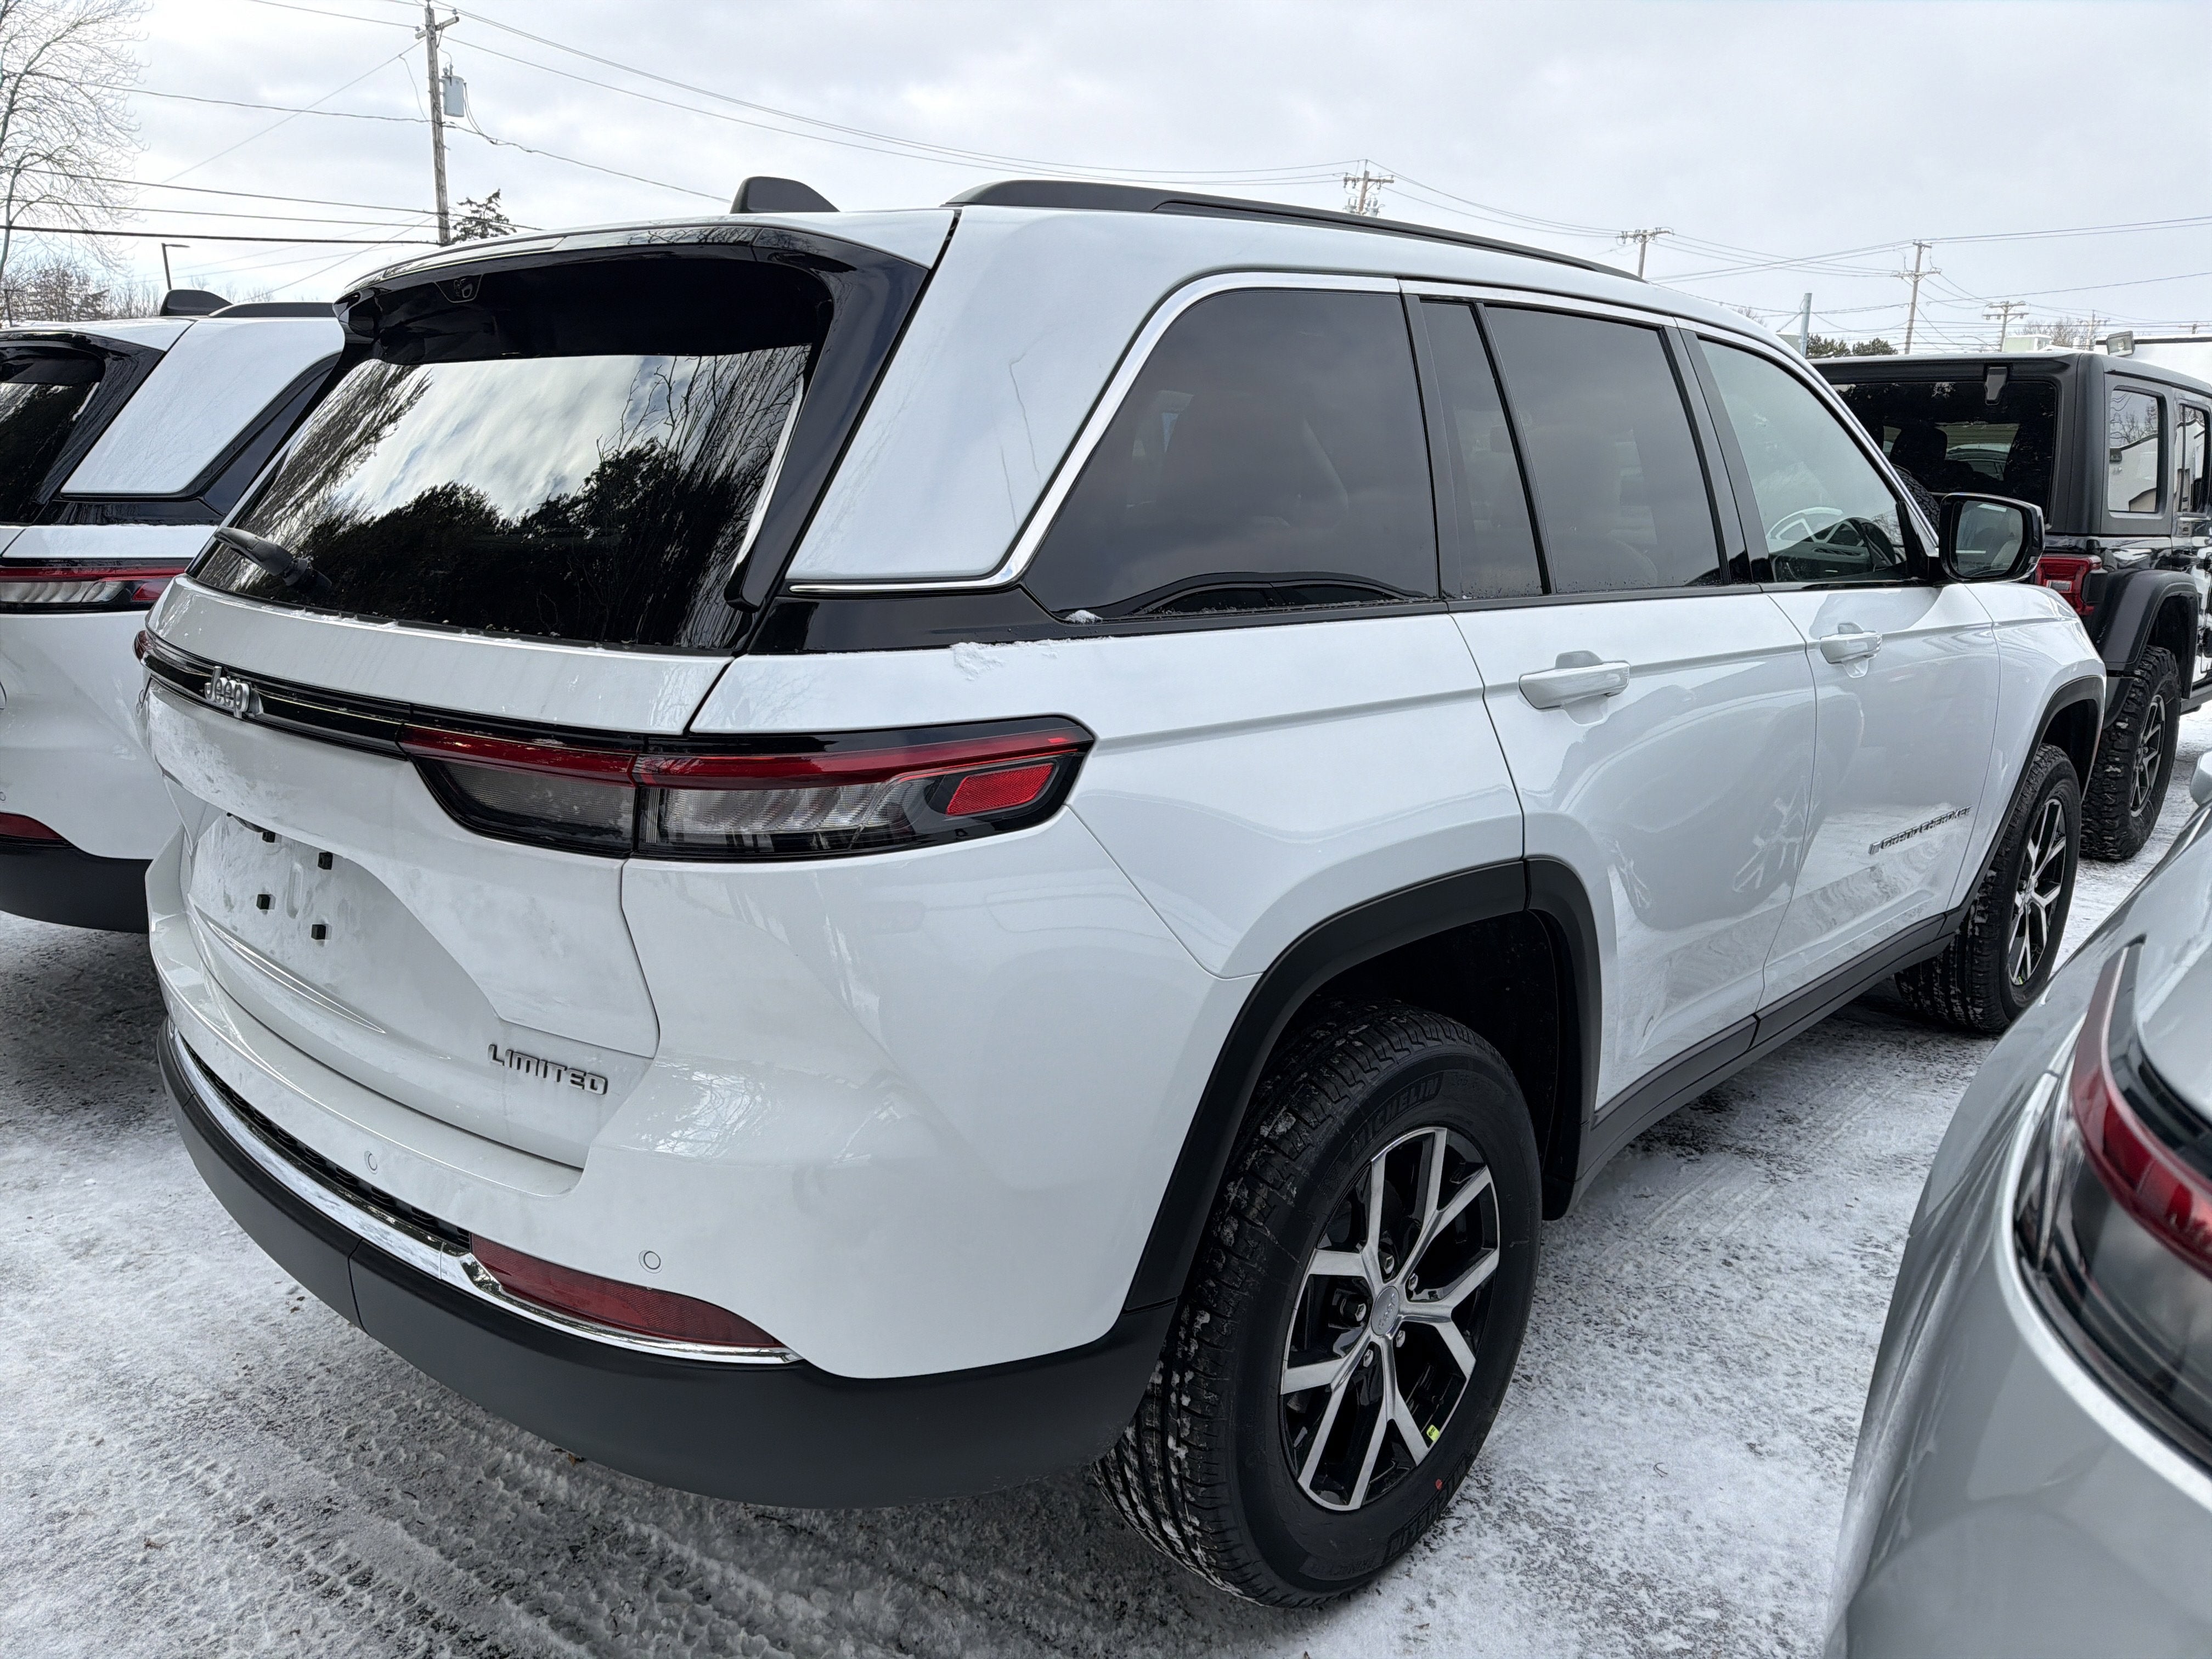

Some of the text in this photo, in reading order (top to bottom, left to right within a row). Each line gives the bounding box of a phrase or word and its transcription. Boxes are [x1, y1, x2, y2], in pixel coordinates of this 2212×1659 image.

[205, 666, 249, 718] Jeep
[488, 1044, 608, 1095] LIMITED
[1351, 1077, 1439, 1159] MICHELIN
